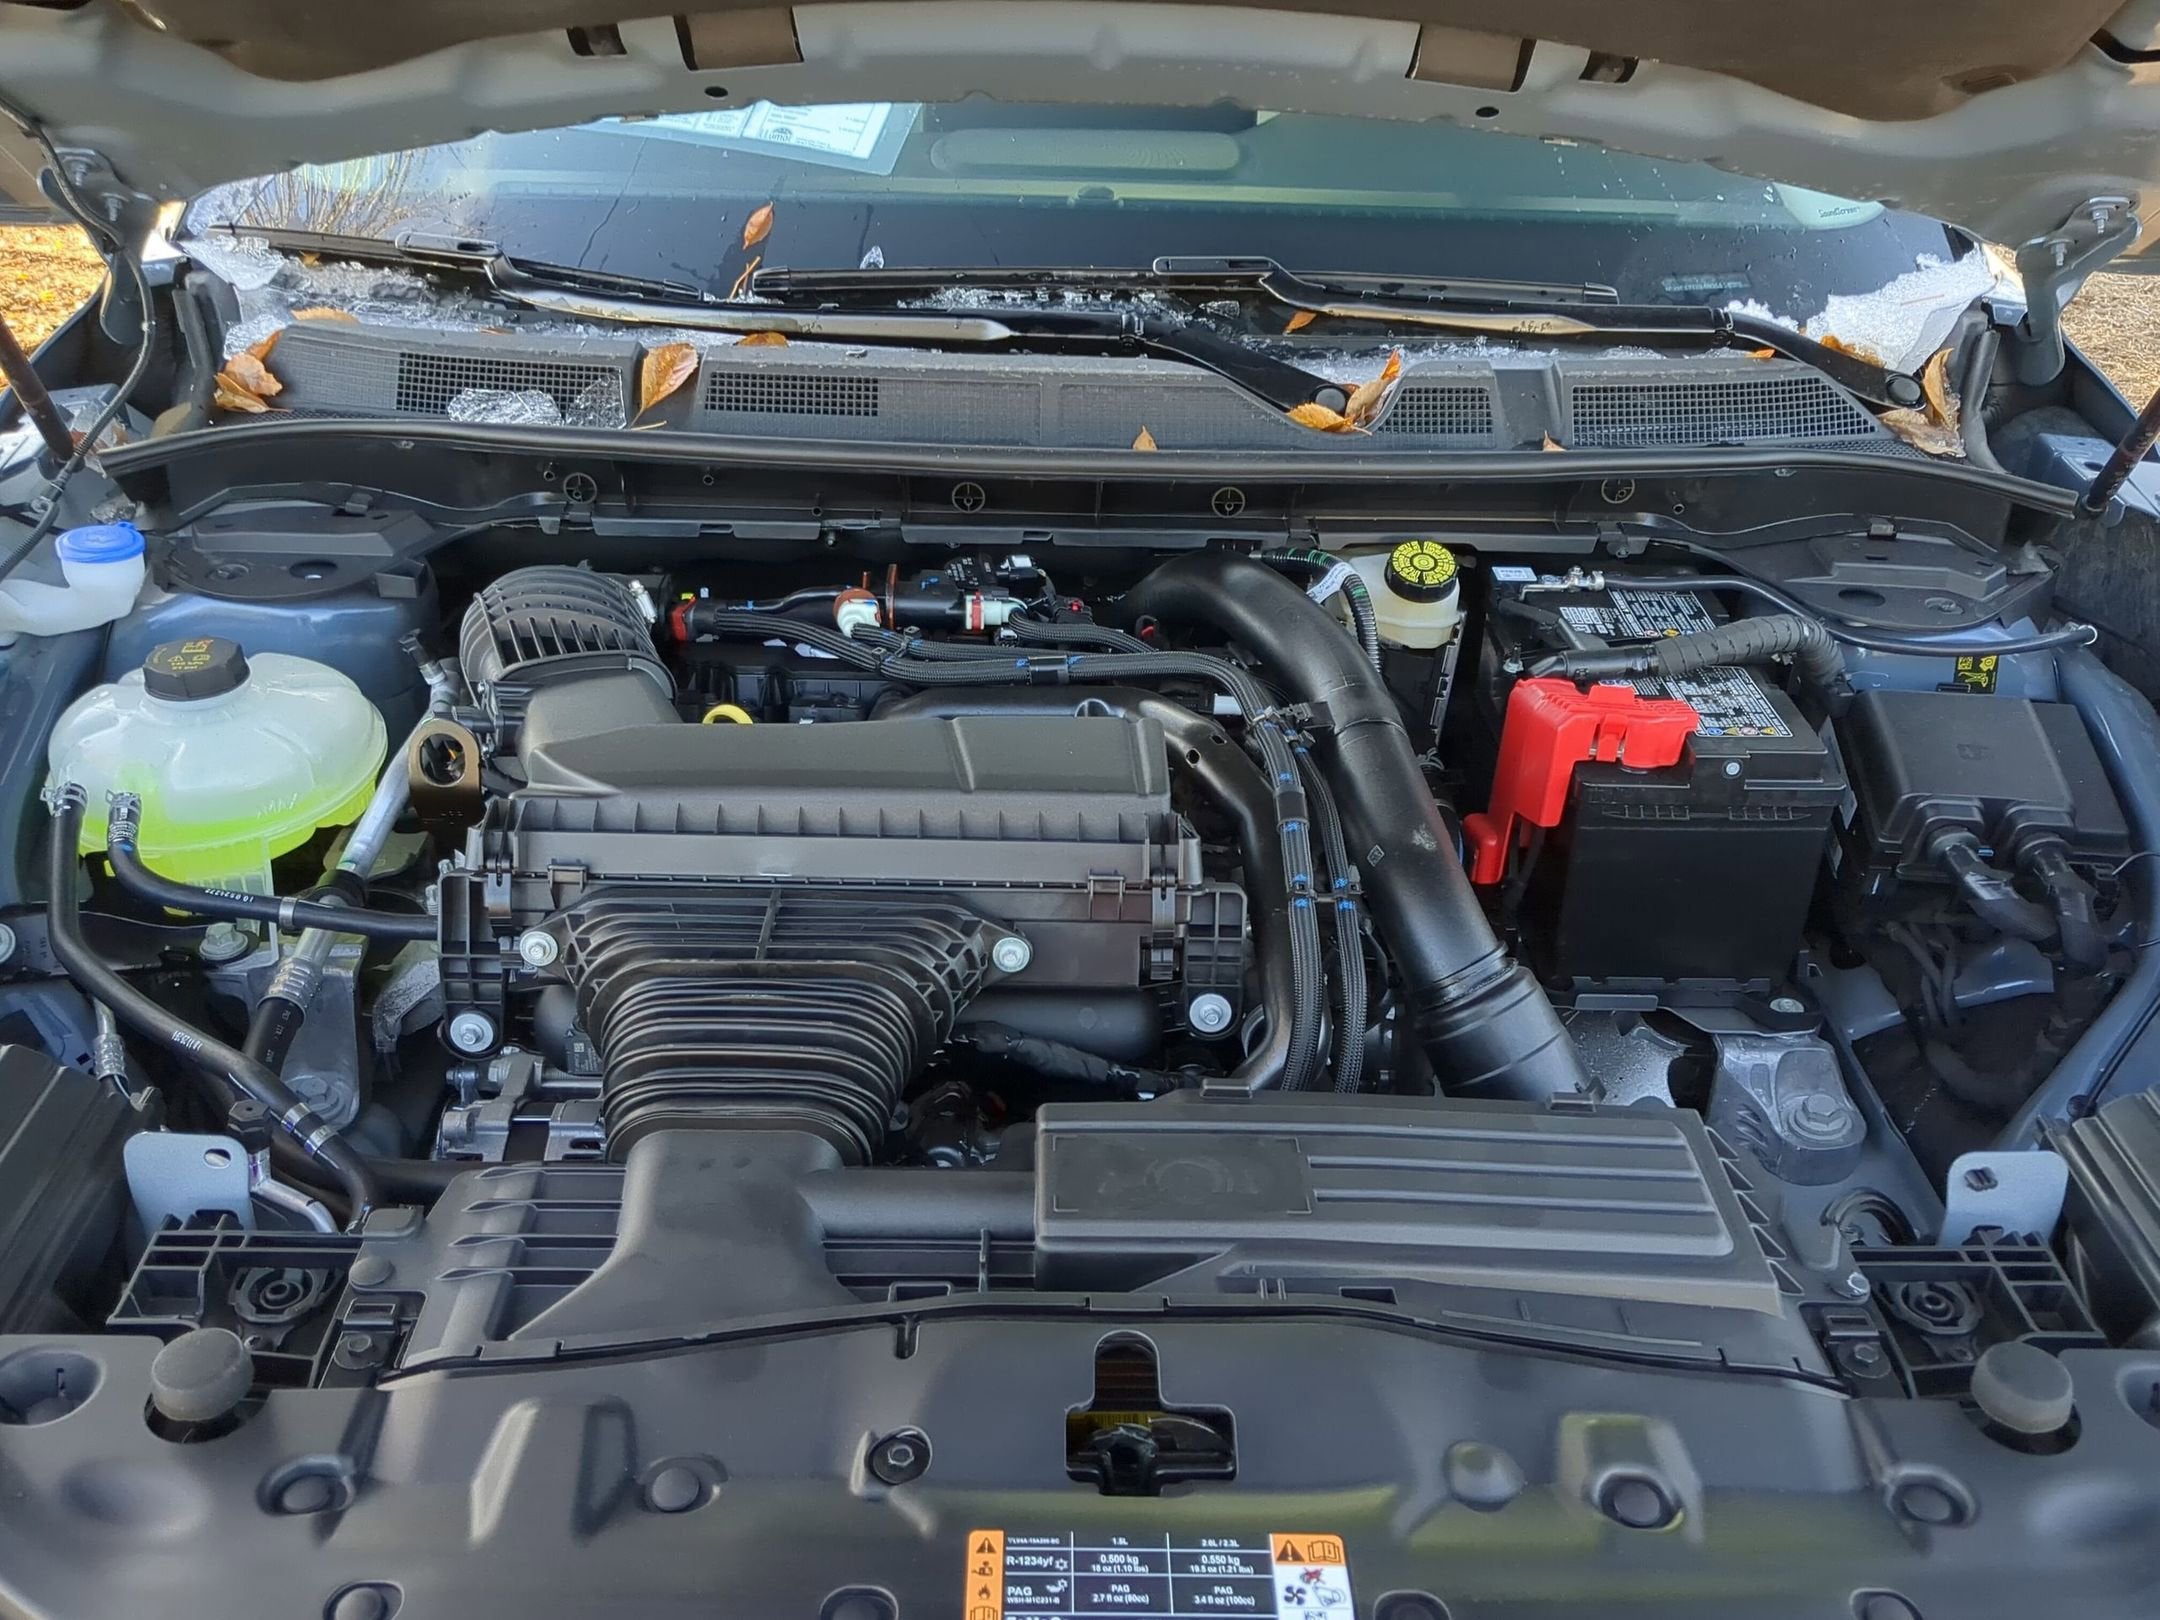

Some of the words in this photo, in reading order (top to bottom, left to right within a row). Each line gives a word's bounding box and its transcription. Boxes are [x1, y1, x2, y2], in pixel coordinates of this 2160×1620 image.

[1006, 1555, 1054, 1568] R-1234yf
[1100, 1554, 1125, 1564] 0.500
[1126, 1554, 1139, 1565] kg
[1227, 1555, 1240, 1566] kg
[1007, 1586, 1032, 1596] PAG
[1111, 1584, 1130, 1593] PAG
[1214, 1586, 1233, 1595] PAG
[1092, 1593, 1105, 1602] 2.7
[1113, 1595, 1123, 1603] oz
[1214, 1597, 1225, 1605] oz
